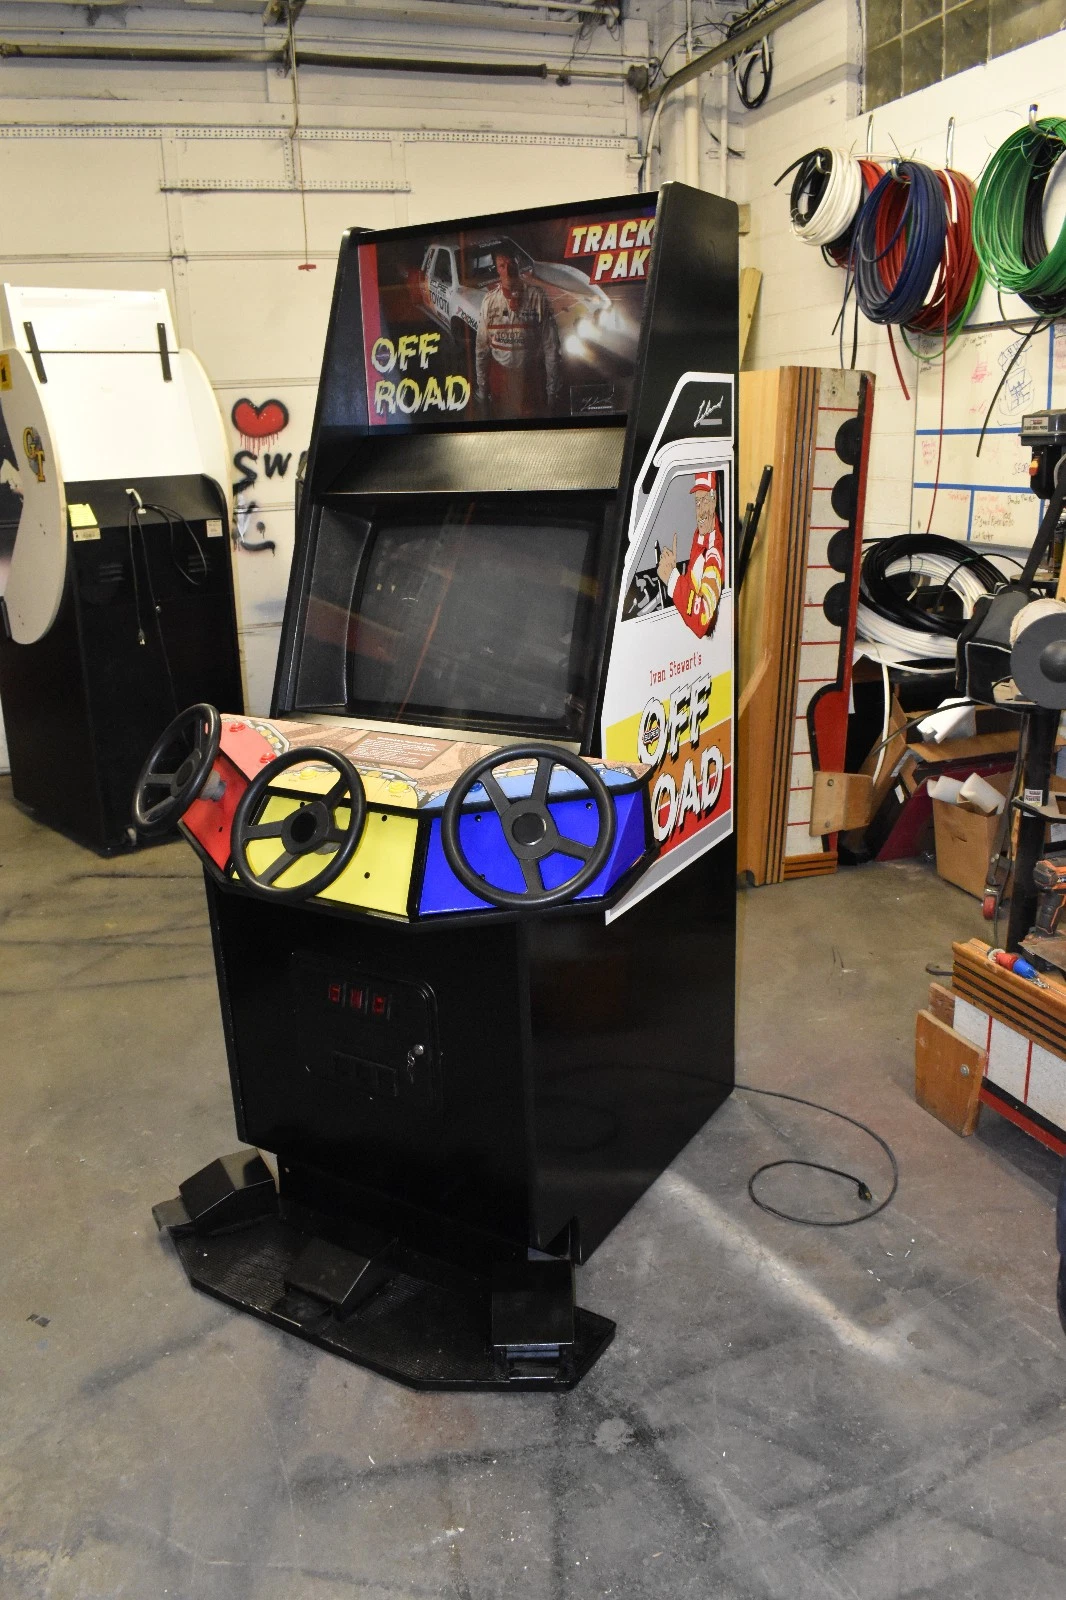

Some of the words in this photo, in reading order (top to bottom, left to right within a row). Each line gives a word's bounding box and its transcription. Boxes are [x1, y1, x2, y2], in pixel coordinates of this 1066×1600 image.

[571, 219, 654, 256] TRACK
[595, 249, 650, 280] PAK
[371, 332, 441, 374] OFF
[373, 375, 471, 415] ROAD
[233, 449, 307, 495] SW
[649, 669, 666, 687] Ivan
[669, 651, 702, 678] Stewart's
[637, 673, 712, 769] OFF
[651, 744, 725, 842] OAD
